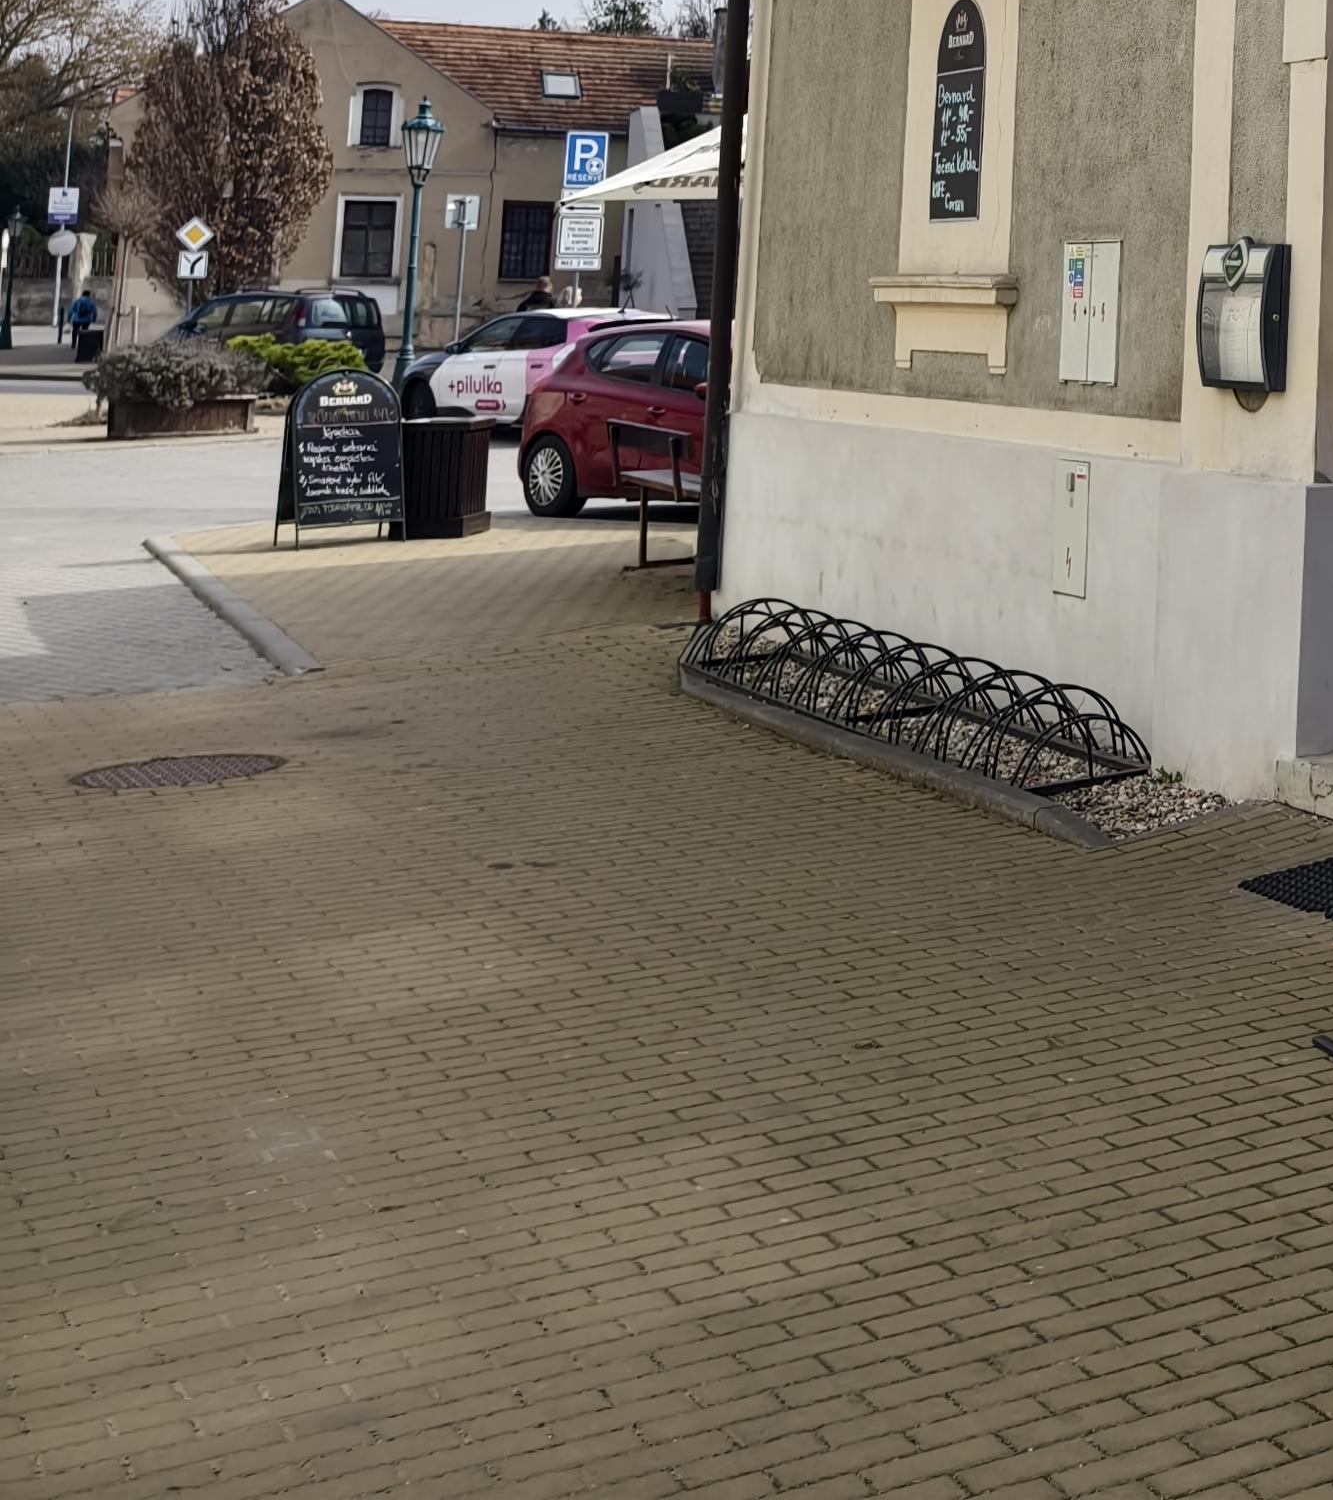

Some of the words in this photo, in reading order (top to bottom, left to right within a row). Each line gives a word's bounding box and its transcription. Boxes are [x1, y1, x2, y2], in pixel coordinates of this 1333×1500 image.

[948, 31, 975, 49] BERNARD
[938, 84, 976, 108] Bernard
[574, 139, 599, 170] P
[320, 393, 373, 407] BERNARD
